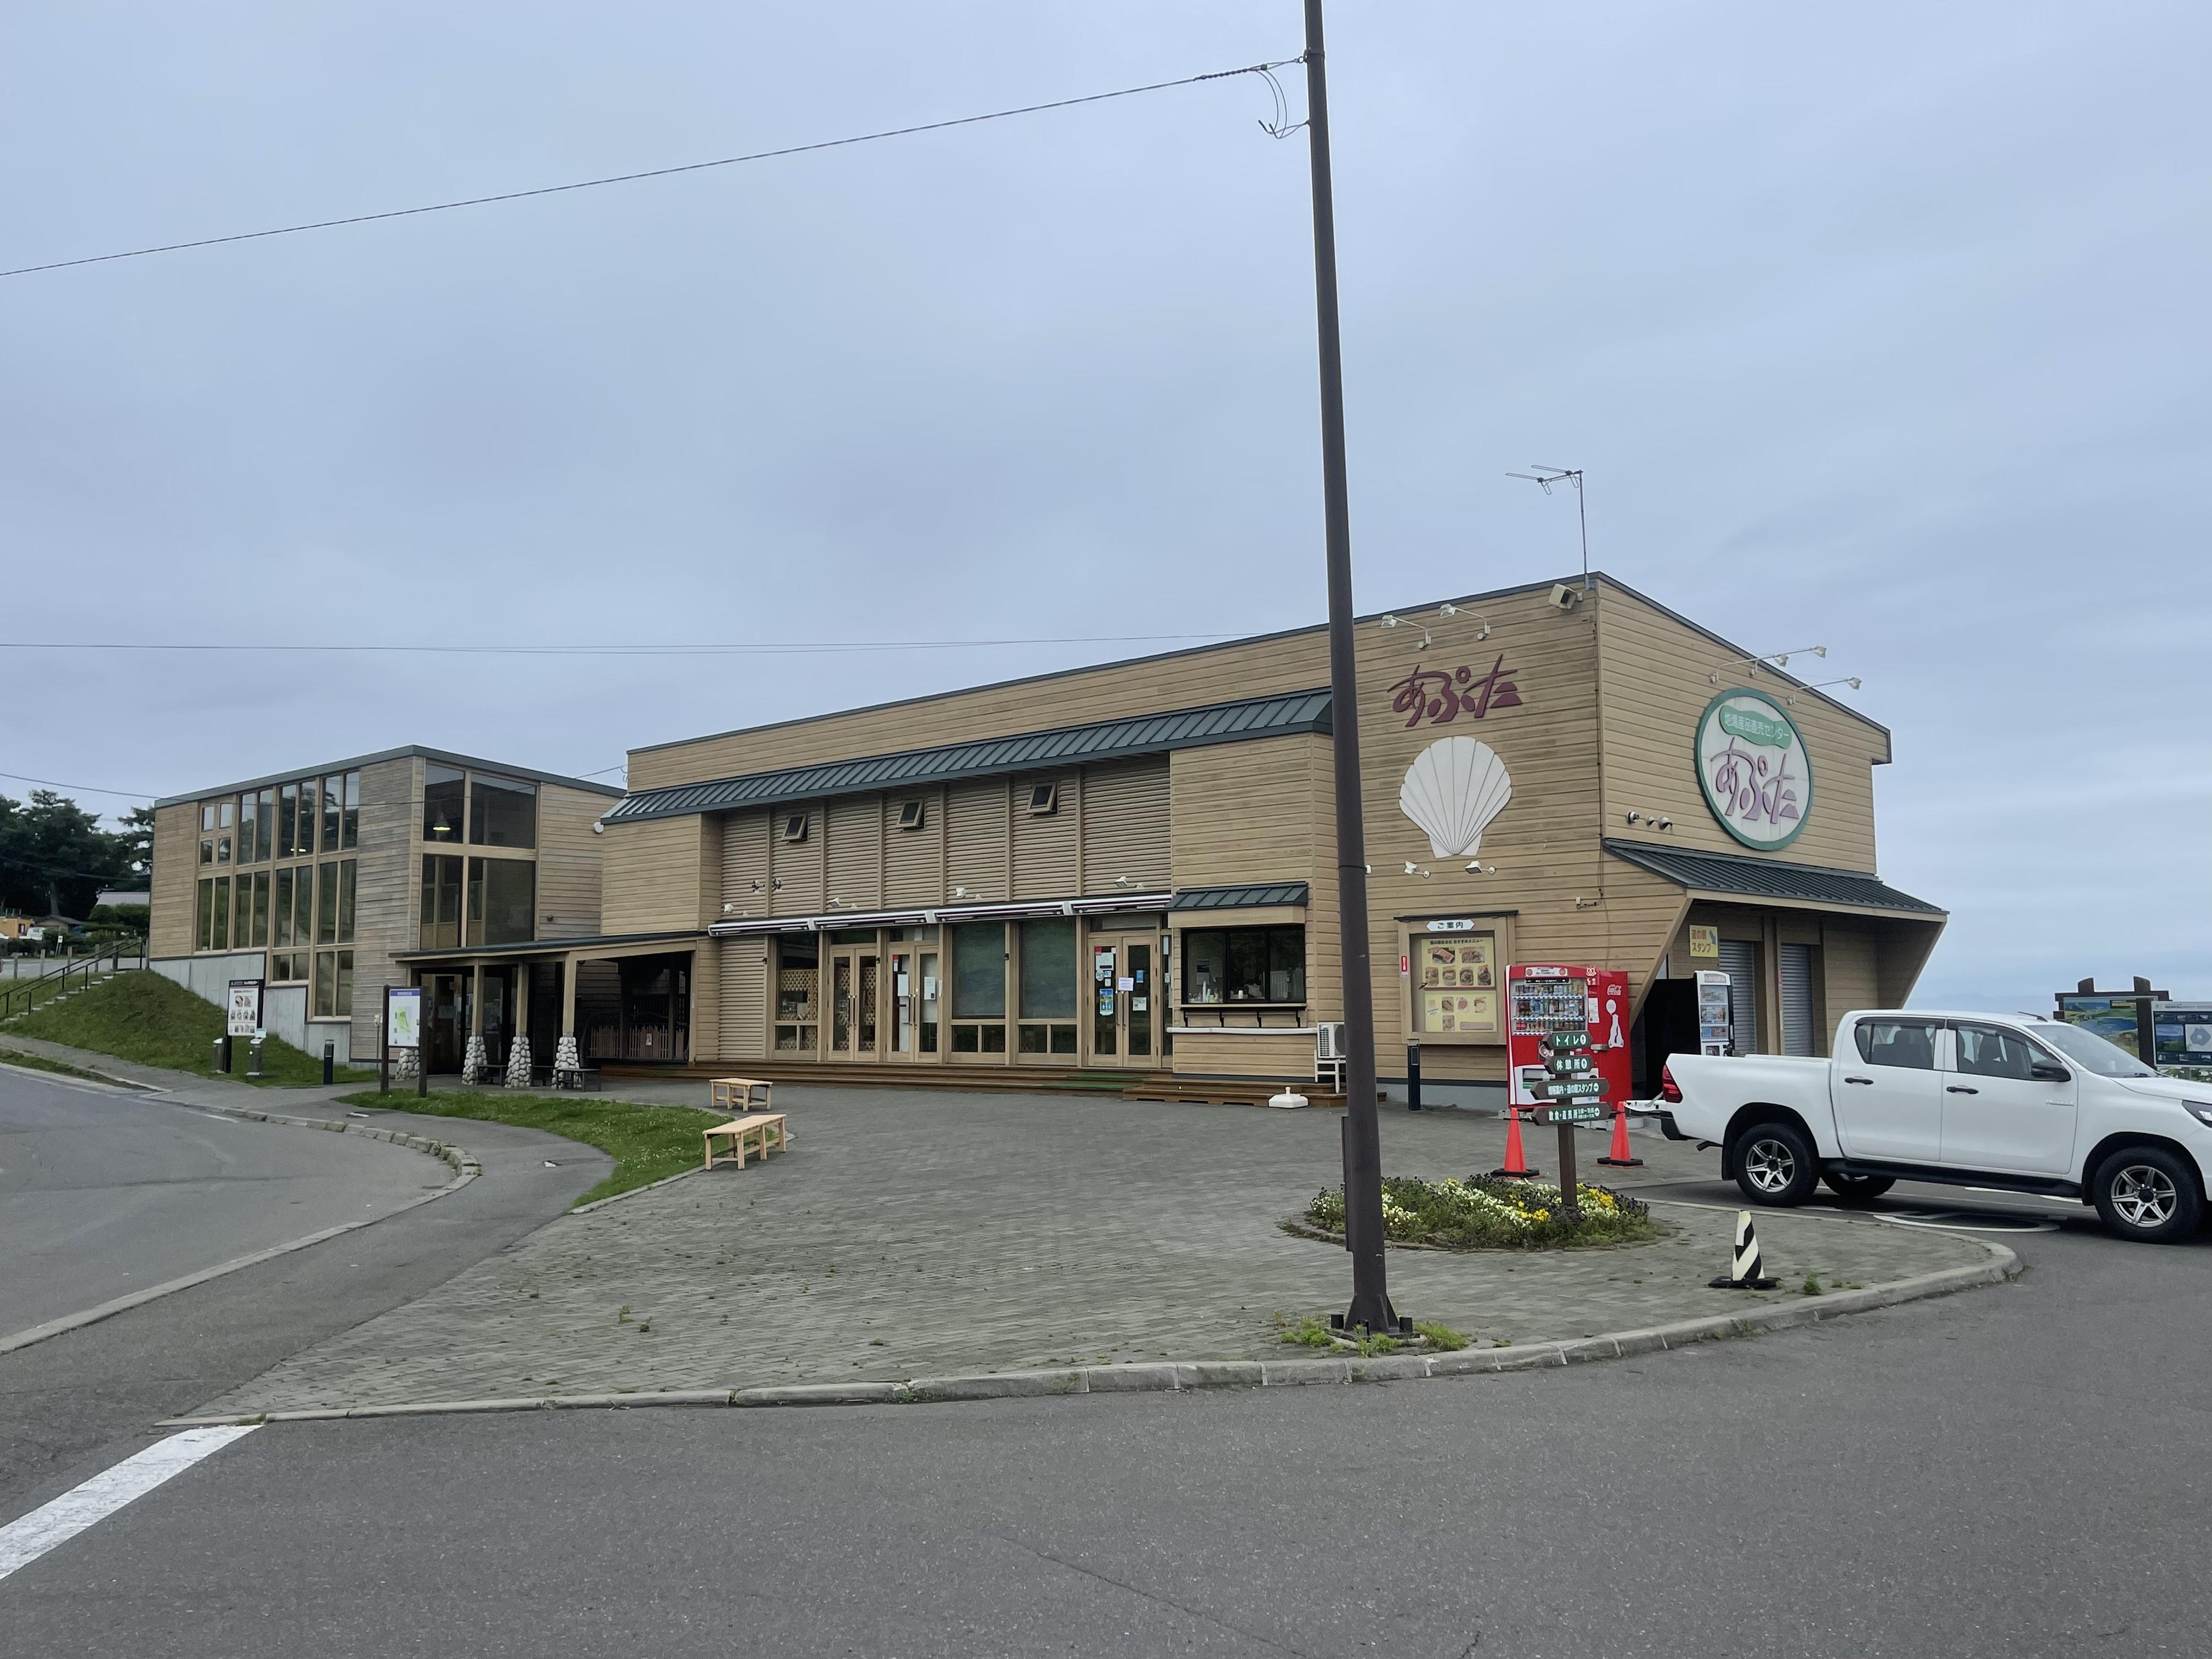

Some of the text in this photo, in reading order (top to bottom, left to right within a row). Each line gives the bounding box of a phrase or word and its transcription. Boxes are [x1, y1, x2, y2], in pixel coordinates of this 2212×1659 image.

[1386, 653, 1523, 727] あぷた
[1710, 737, 1800, 825] あぷた
[1692, 943, 1711, 953] スタンプ
[1556, 1035, 1579, 1046] トイレ
